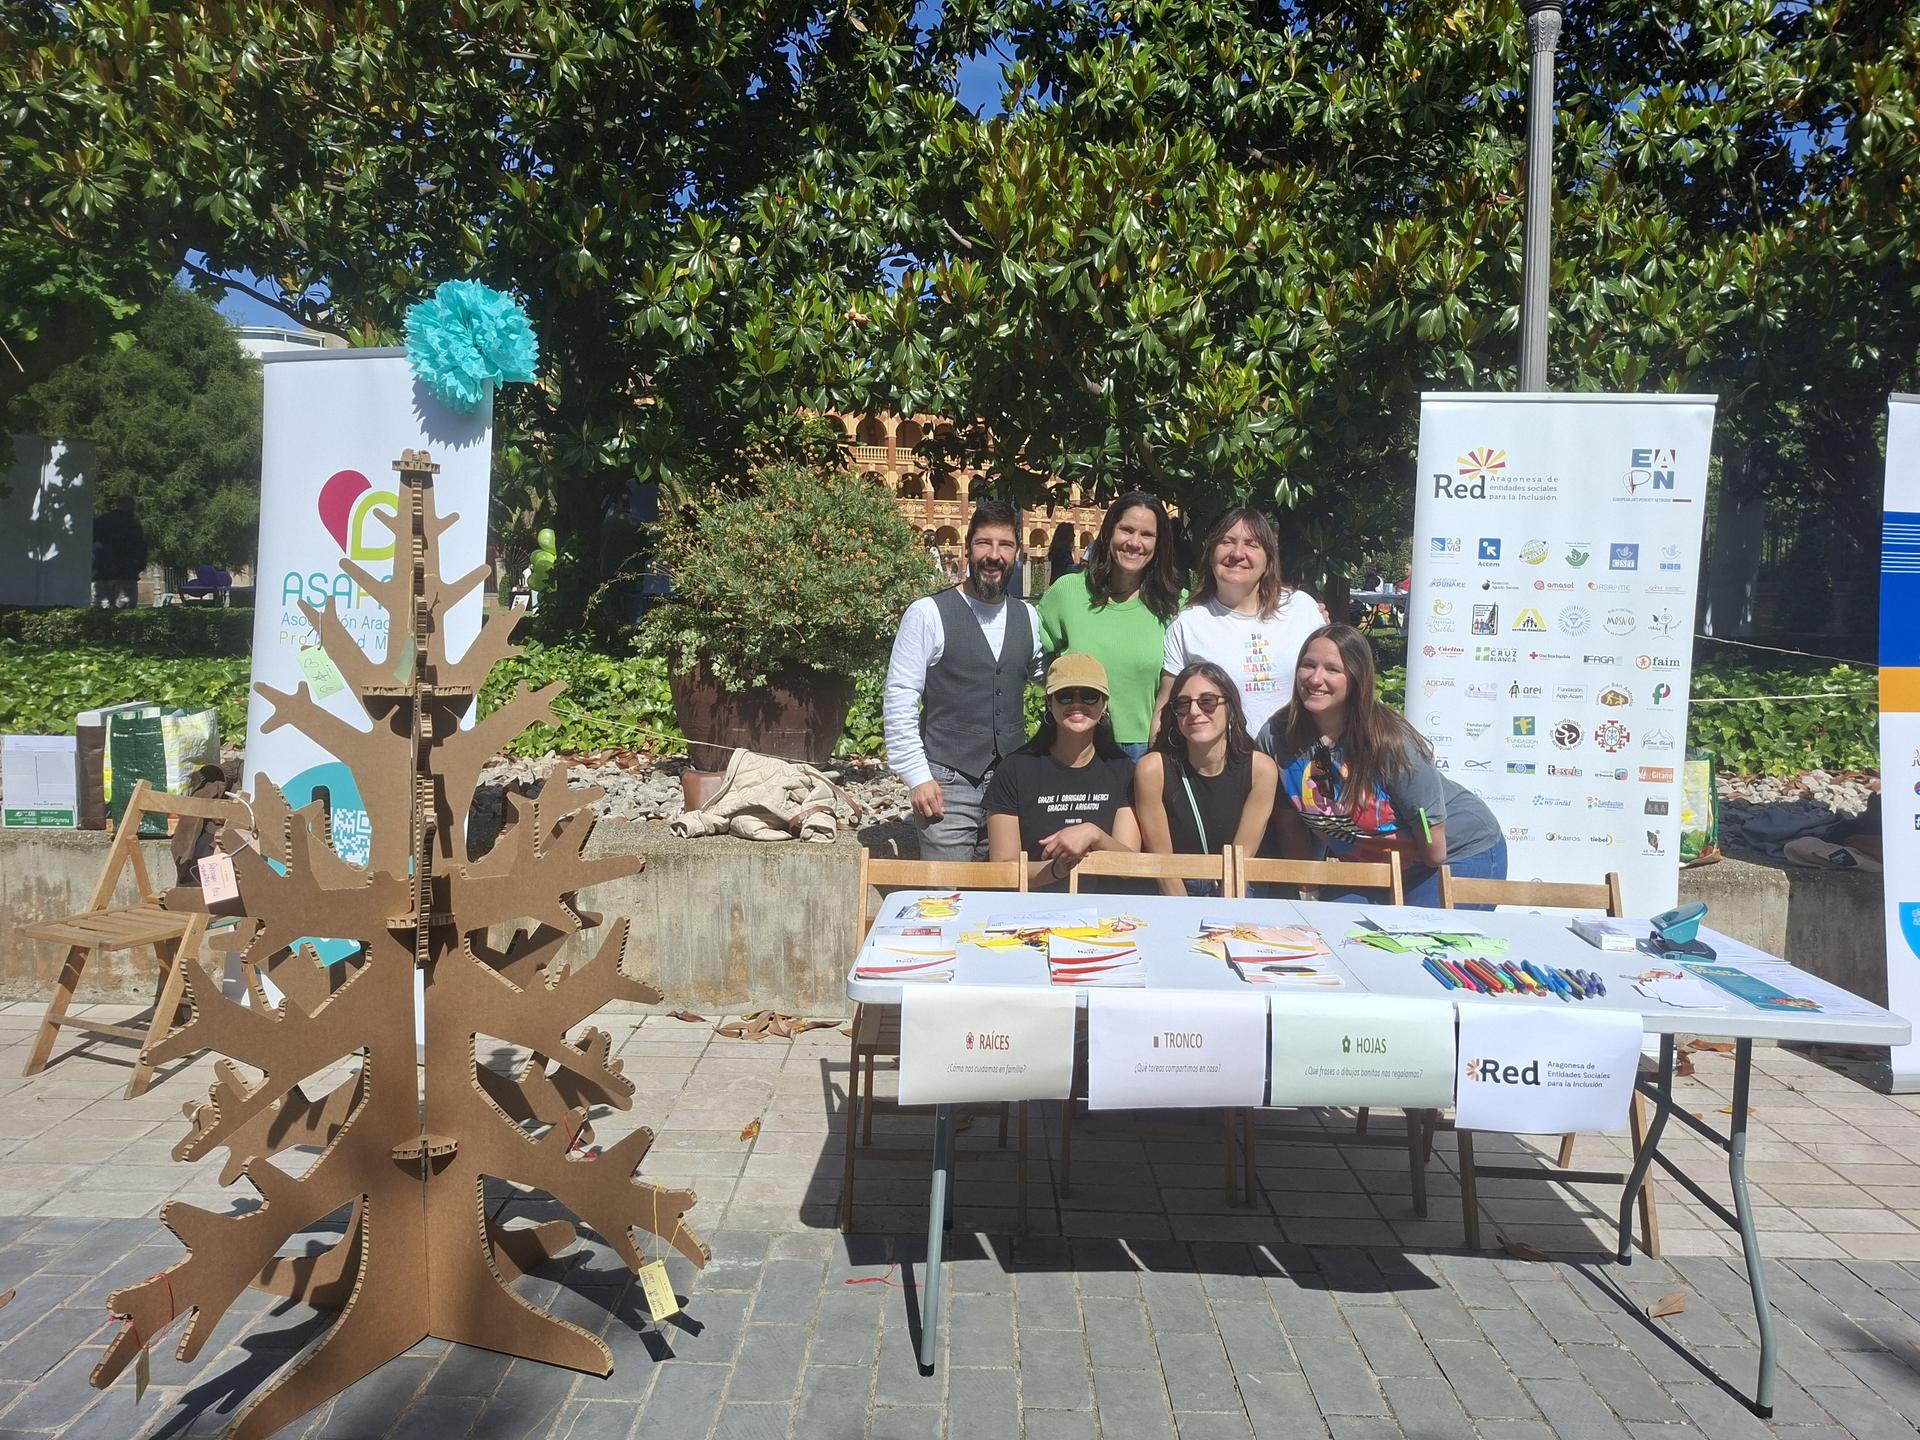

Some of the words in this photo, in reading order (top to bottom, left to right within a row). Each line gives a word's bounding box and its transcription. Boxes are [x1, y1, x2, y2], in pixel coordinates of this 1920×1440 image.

[1490, 475, 1542, 484] Aragonesa
[1433, 474, 1486, 499] Red
[1508, 493, 1516, 501] la
[1518, 493, 1557, 501] Inclusión
[1490, 649, 1517, 657] CRUZ
[1652, 657, 1680, 667] faim
[1037, 795, 1055, 804] GRAZIE
[1061, 794, 1086, 802] OBRIGADO
[1092, 793, 1109, 801] MERCI
[1047, 804, 1069, 812] GRACIAS
[1075, 803, 1100, 811] ARIGATOU
[1558, 834, 1580, 842] kairos
[979, 1030, 1010, 1051] RAÍCES
[1164, 1032, 1203, 1049] TRONCO
[1356, 1037, 1387, 1054] HOJAS
[965, 1065, 973, 1073] nos
[974, 1064, 998, 1073] cuidamos
[998, 1065, 1005, 1073] en
[1005, 1064, 1026, 1075] familia?
[1148, 1064, 1165, 1073] tareas
[1165, 1063, 1198, 1075] compartimos
[1199, 1065, 1206, 1073] en
[1206, 1064, 1221, 1073] casa?
[1547, 1061, 1585, 1070] Aragonesa
[1319, 1066, 1335, 1077] frases
[1341, 1067, 1360, 1078] dibujos
[1360, 1067, 1380, 1077] bonitos
[1391, 1068, 1423, 1080] regalamos?
[1480, 1058, 1541, 1086] Red
[1547, 1070, 1581, 1079] Entidades
[1583, 1071, 1611, 1079] Sociales
